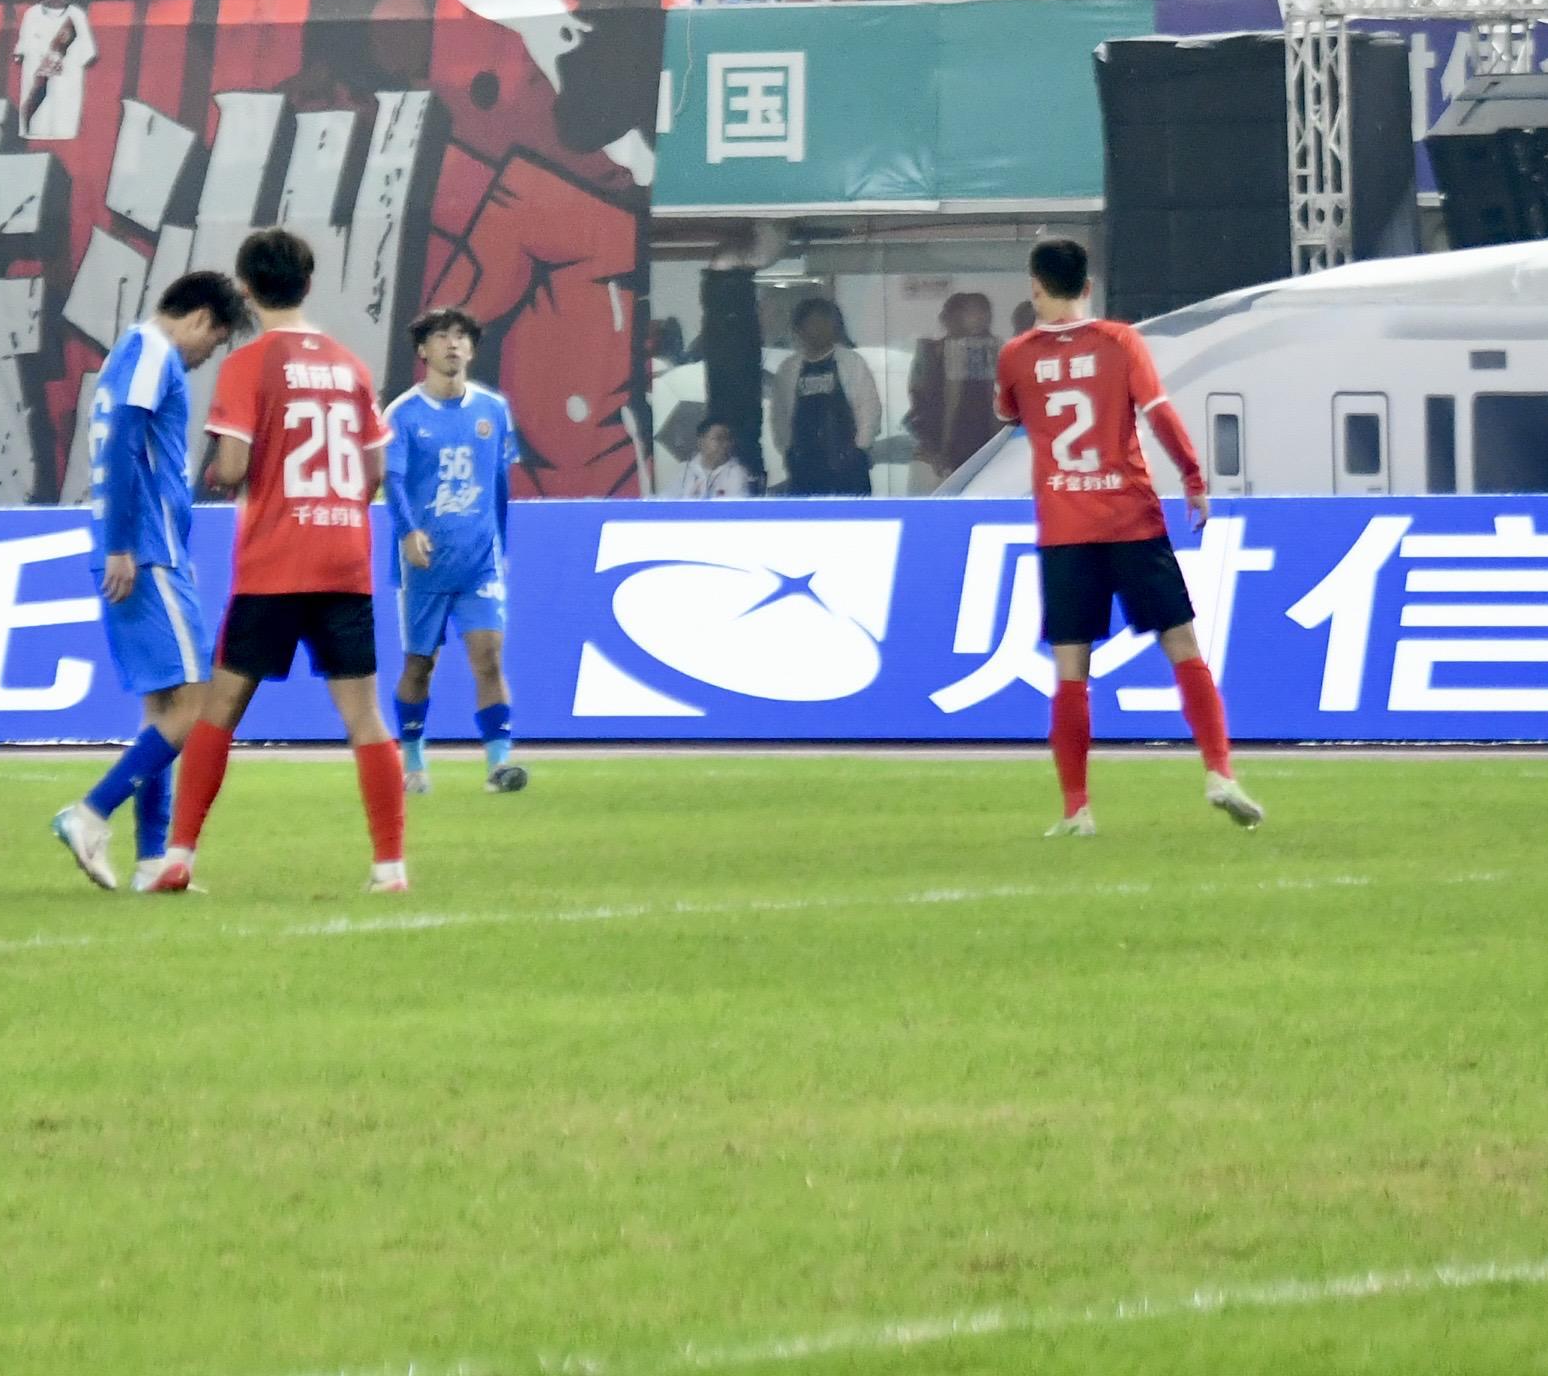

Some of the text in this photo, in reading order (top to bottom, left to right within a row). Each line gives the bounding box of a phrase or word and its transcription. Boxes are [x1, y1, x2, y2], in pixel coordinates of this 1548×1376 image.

[659, 50, 807, 165] 国
[282, 400, 367, 501] 26
[437, 446, 474, 482] 56
[1044, 389, 1100, 473] 2
